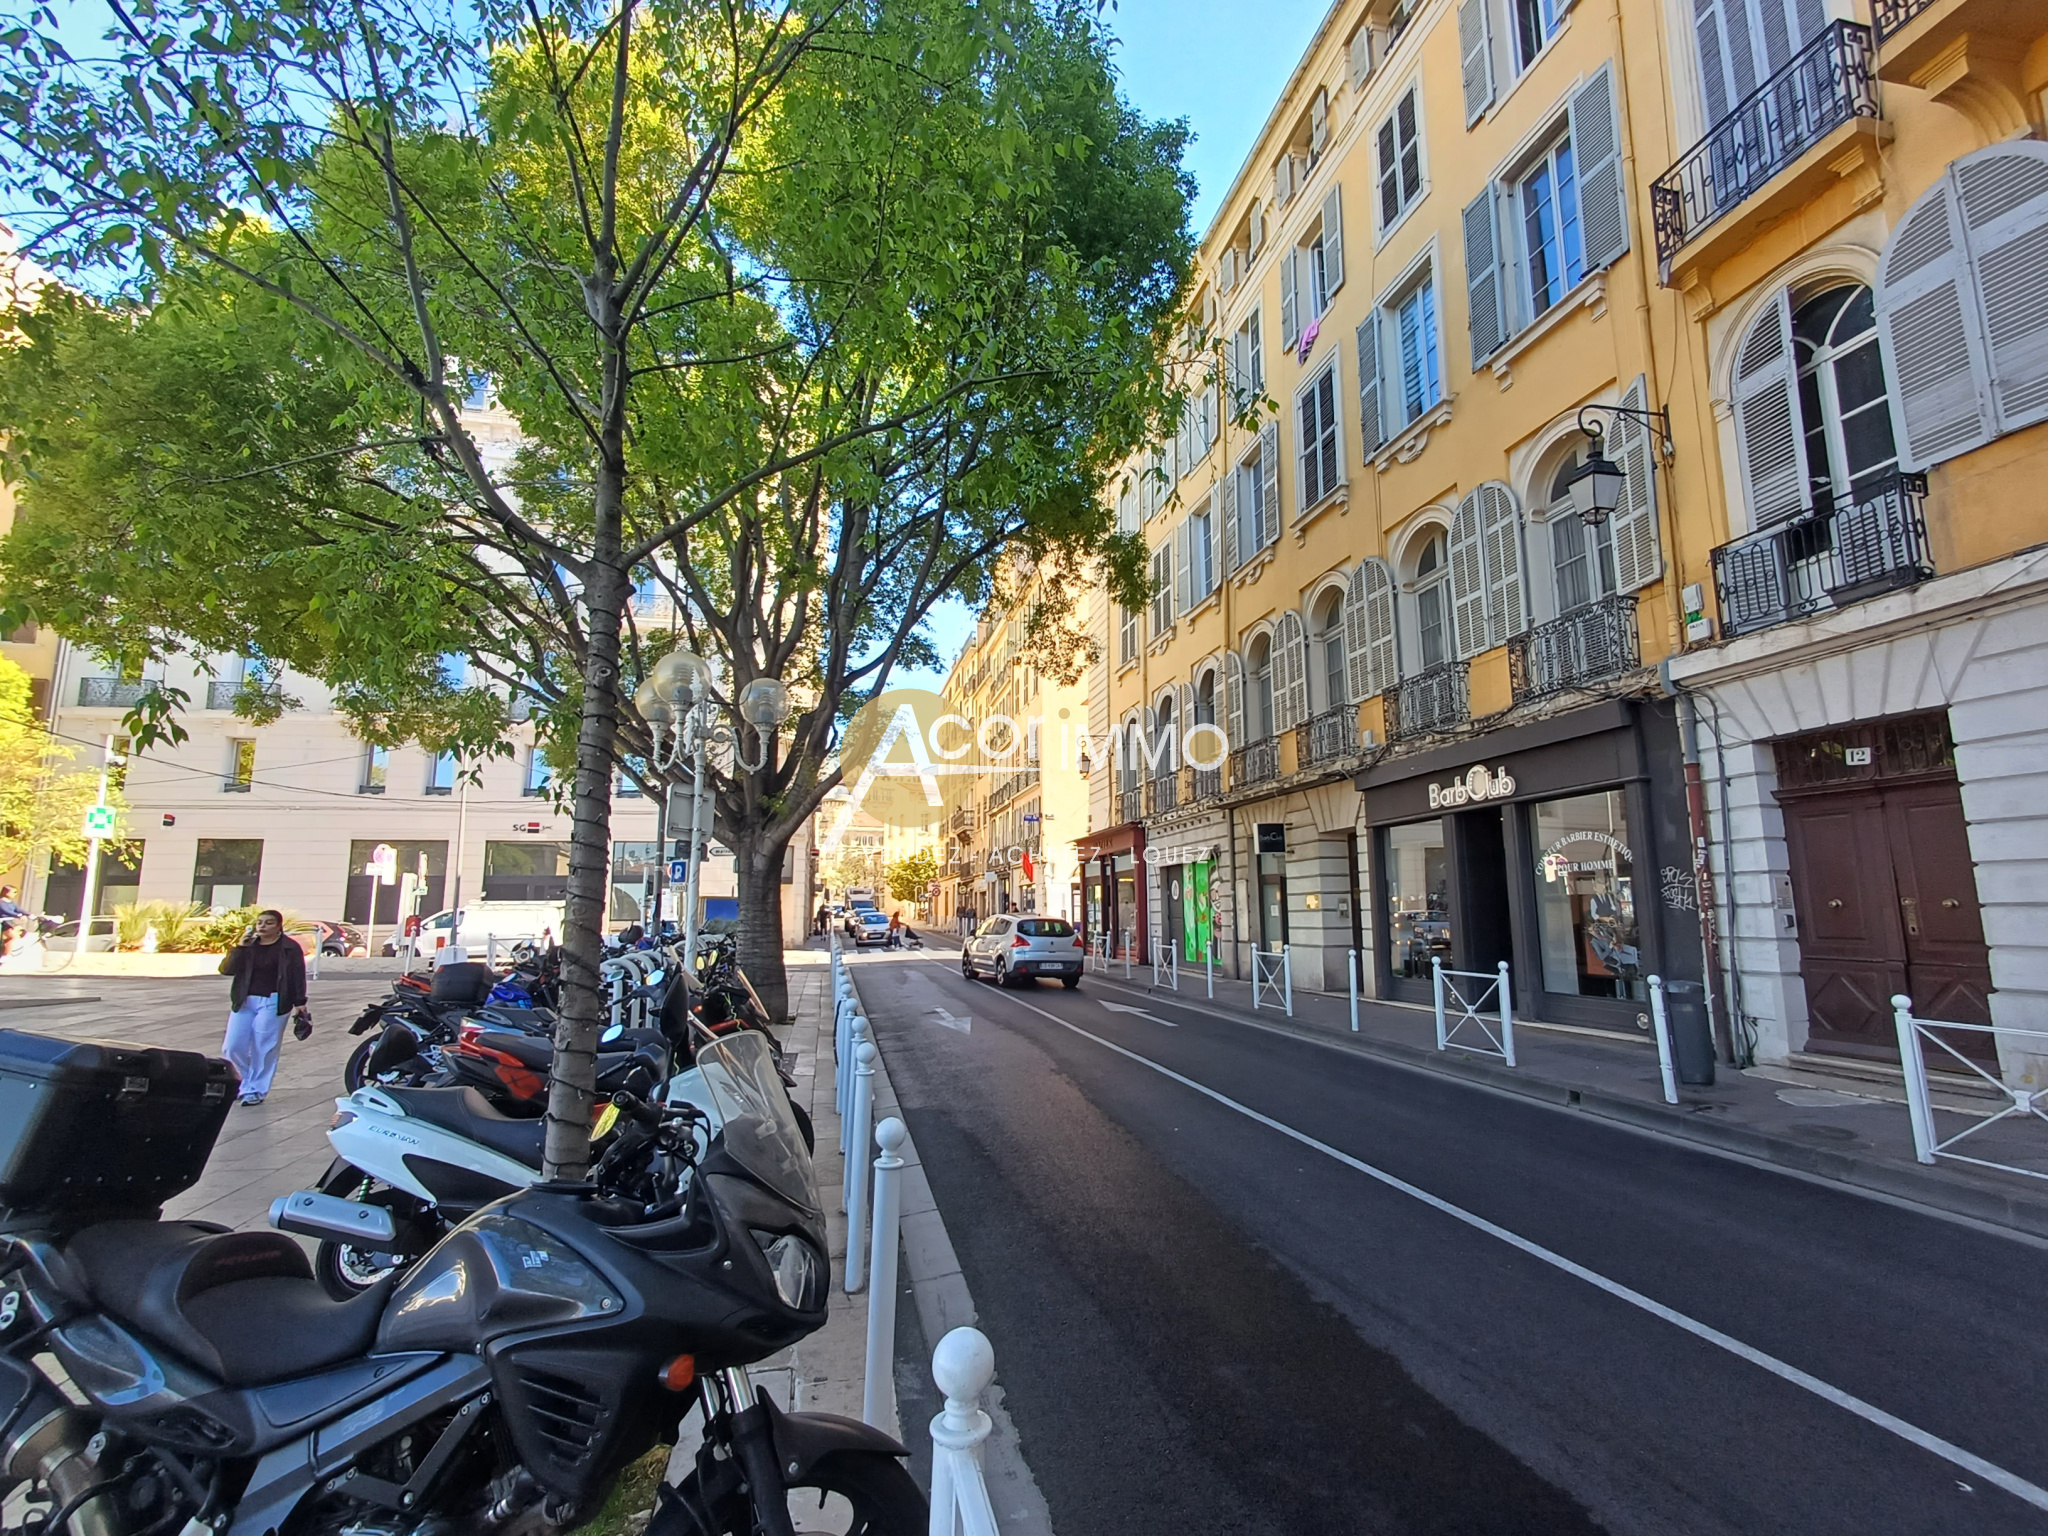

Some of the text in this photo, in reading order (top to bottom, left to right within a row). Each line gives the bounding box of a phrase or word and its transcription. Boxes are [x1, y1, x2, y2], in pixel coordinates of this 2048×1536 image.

[1851, 750, 1865, 762] 12
[512, 824, 527, 832] SG
[1561, 831, 1593, 846] BARBIER
[1557, 860, 1613, 872] POUR HOMME
